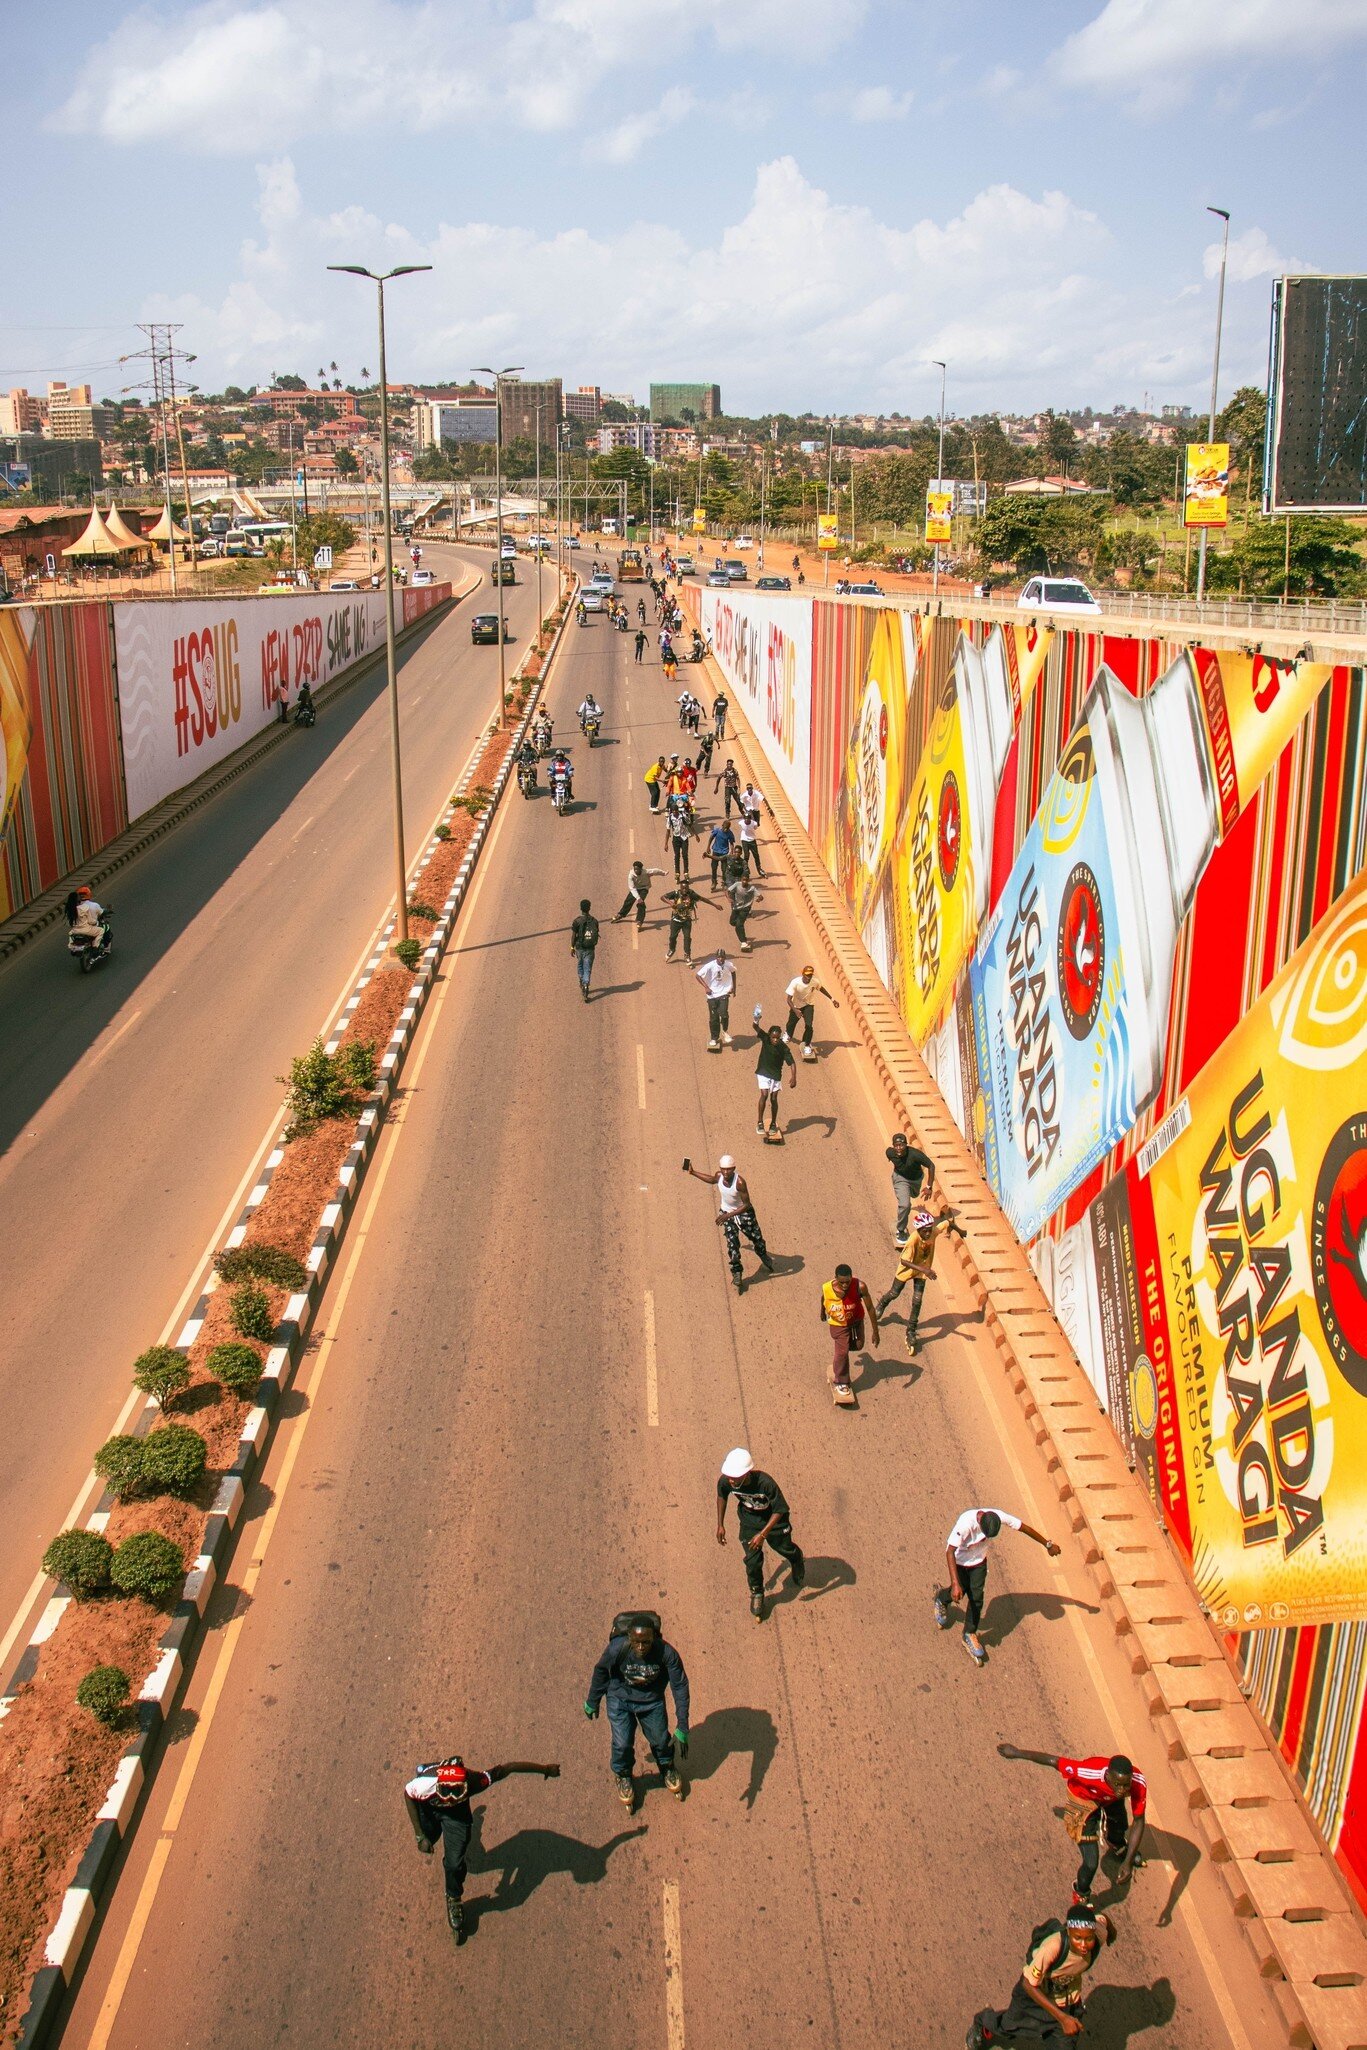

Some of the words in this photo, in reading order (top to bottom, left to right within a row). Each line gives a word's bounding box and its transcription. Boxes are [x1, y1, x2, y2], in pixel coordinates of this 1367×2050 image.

[262, 628, 289, 711] NEW
[327, 605, 351, 671] SAME
[1203, 659, 1235, 802] UGANDA
[862, 697, 880, 843] UGANDA
[911, 814, 931, 1005] WARAGI
[917, 777, 941, 992] UGANDA
[1071, 867, 1084, 884] THE
[1084, 868, 1102, 913] SPIRIT
[1099, 923, 1104, 945] OF
[976, 993, 990, 1084] COCONUT
[1006, 912, 1043, 1182] WARAGI
[1018, 861, 1061, 1172] UGANDA
[1088, 956, 1104, 1025] UGANDA
[994, 1034, 1007, 1133] LIQUEUR
[997, 1009, 1014, 1143] PREMIUM
[1097, 1222, 1108, 1248] ABV
[1122, 1223, 1132, 1269] MONDE
[1127, 1271, 1141, 1346] SELECTION
[1314, 1200, 1326, 1287] SINCE
[1322, 1302, 1348, 1362] 1965
[1109, 1231, 1122, 1323] DEMINERALIZED
[1119, 1326, 1130, 1376] WATER,
[1125, 1380, 1135, 1438] NEUTRAL
[1144, 1258, 1161, 1322] THE
[1153, 1334, 1182, 1511] ORIGINAL
[1167, 1232, 1198, 1432] FLAVOURED
[1192, 1445, 1206, 1505] GIN
[1182, 1254, 1217, 1470] PREMIUM
[1199, 1124, 1279, 1551] WARAGI
[1228, 1066, 1326, 1562] UGANDA
